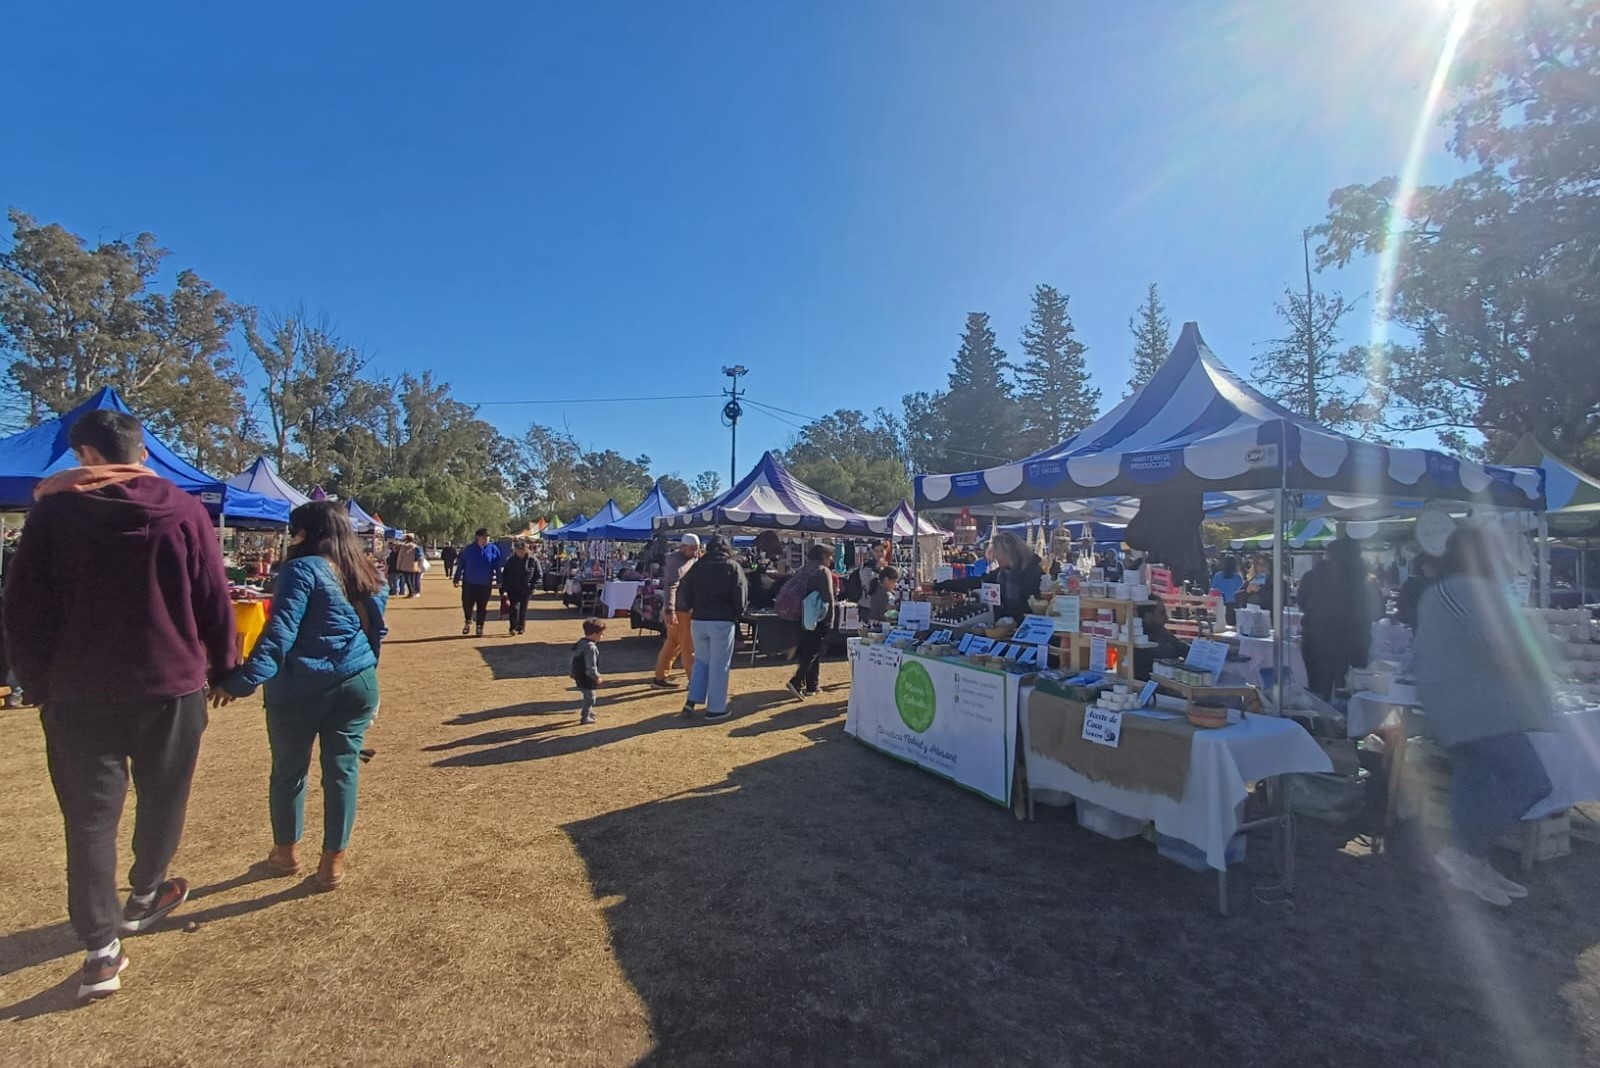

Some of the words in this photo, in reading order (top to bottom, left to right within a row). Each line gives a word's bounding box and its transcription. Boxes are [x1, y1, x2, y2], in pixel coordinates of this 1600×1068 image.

[1088, 710, 1108, 721] Aceite
[1109, 715, 1118, 724] de
[1086, 719, 1102, 729] Coco
